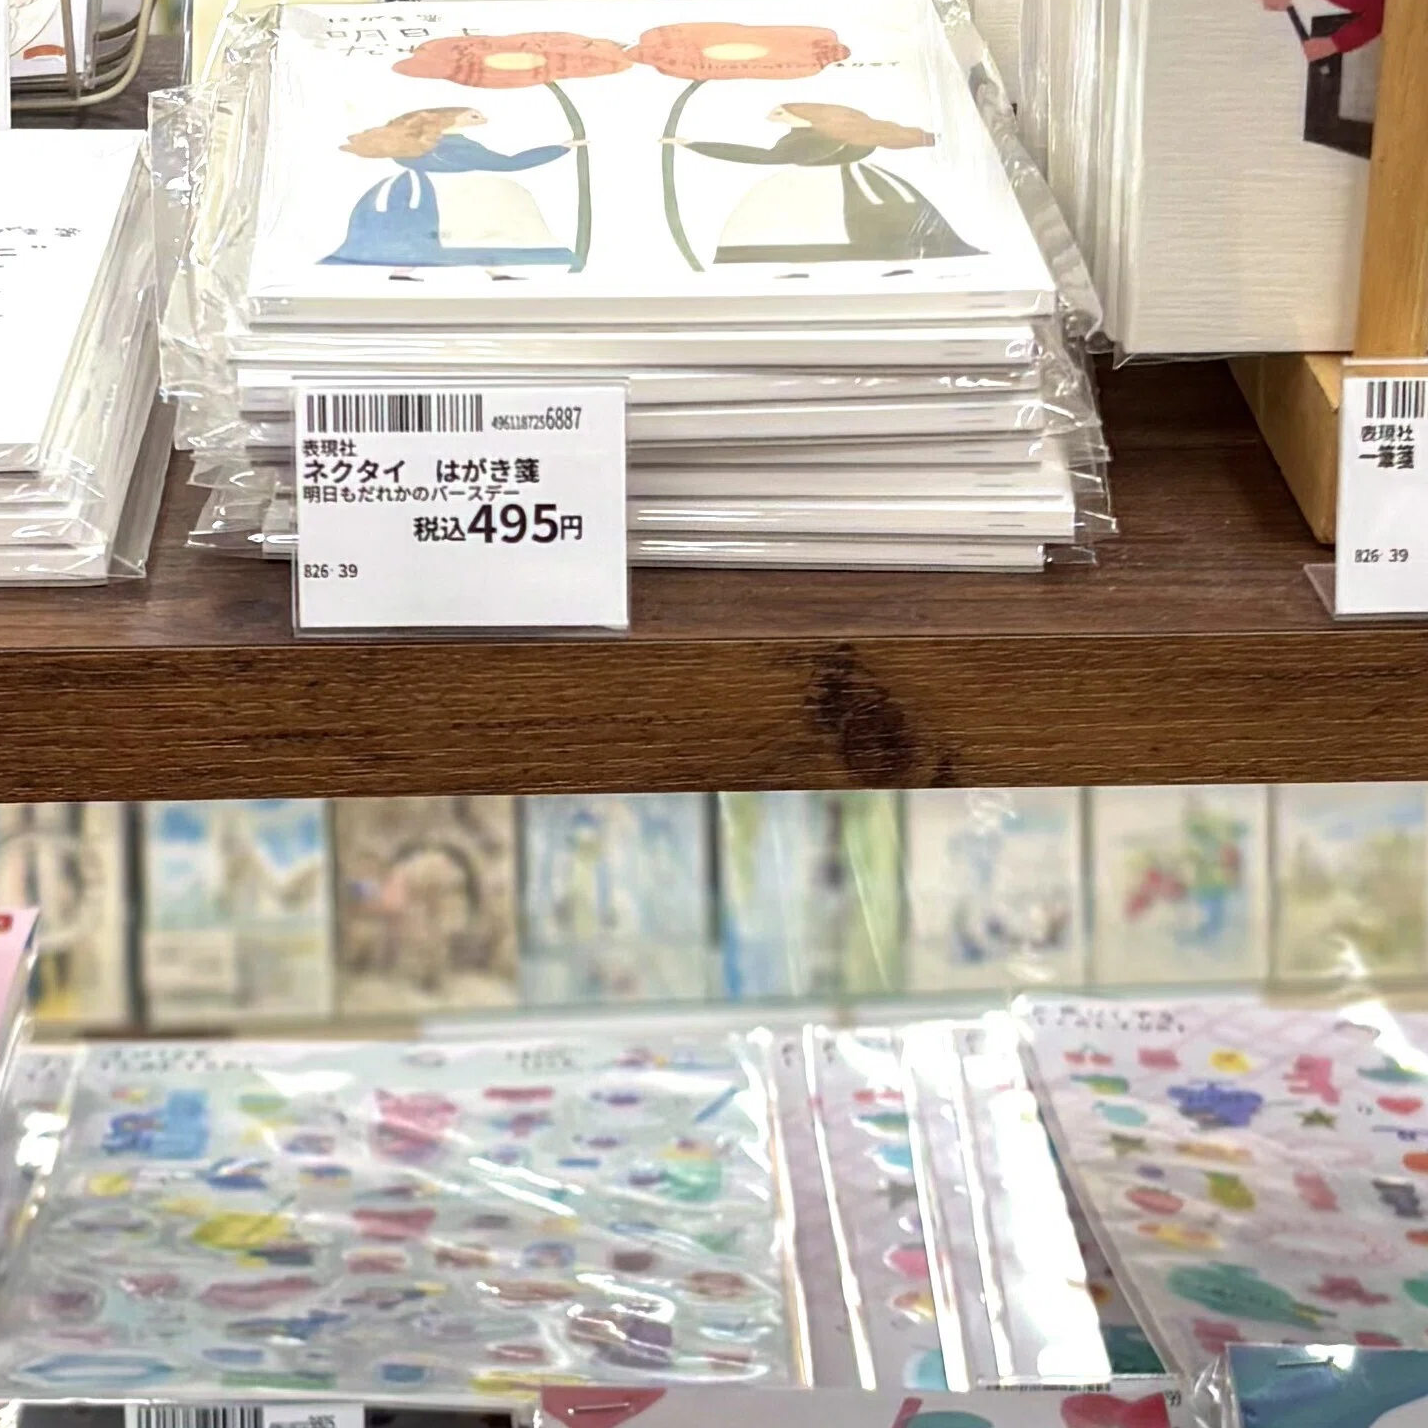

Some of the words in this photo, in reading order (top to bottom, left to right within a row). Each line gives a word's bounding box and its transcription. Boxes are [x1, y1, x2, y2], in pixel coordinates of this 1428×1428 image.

[303, 440, 358, 457] 表現社
[304, 460, 406, 484] ネクタイ
[436, 458, 540, 483] はがき箋
[303, 486, 520, 503] 明日もだれかのバースデー
[413, 503, 583, 543] 税込495円
[1389, 549, 1408, 563] 39
[339, 564, 358, 578] 39
